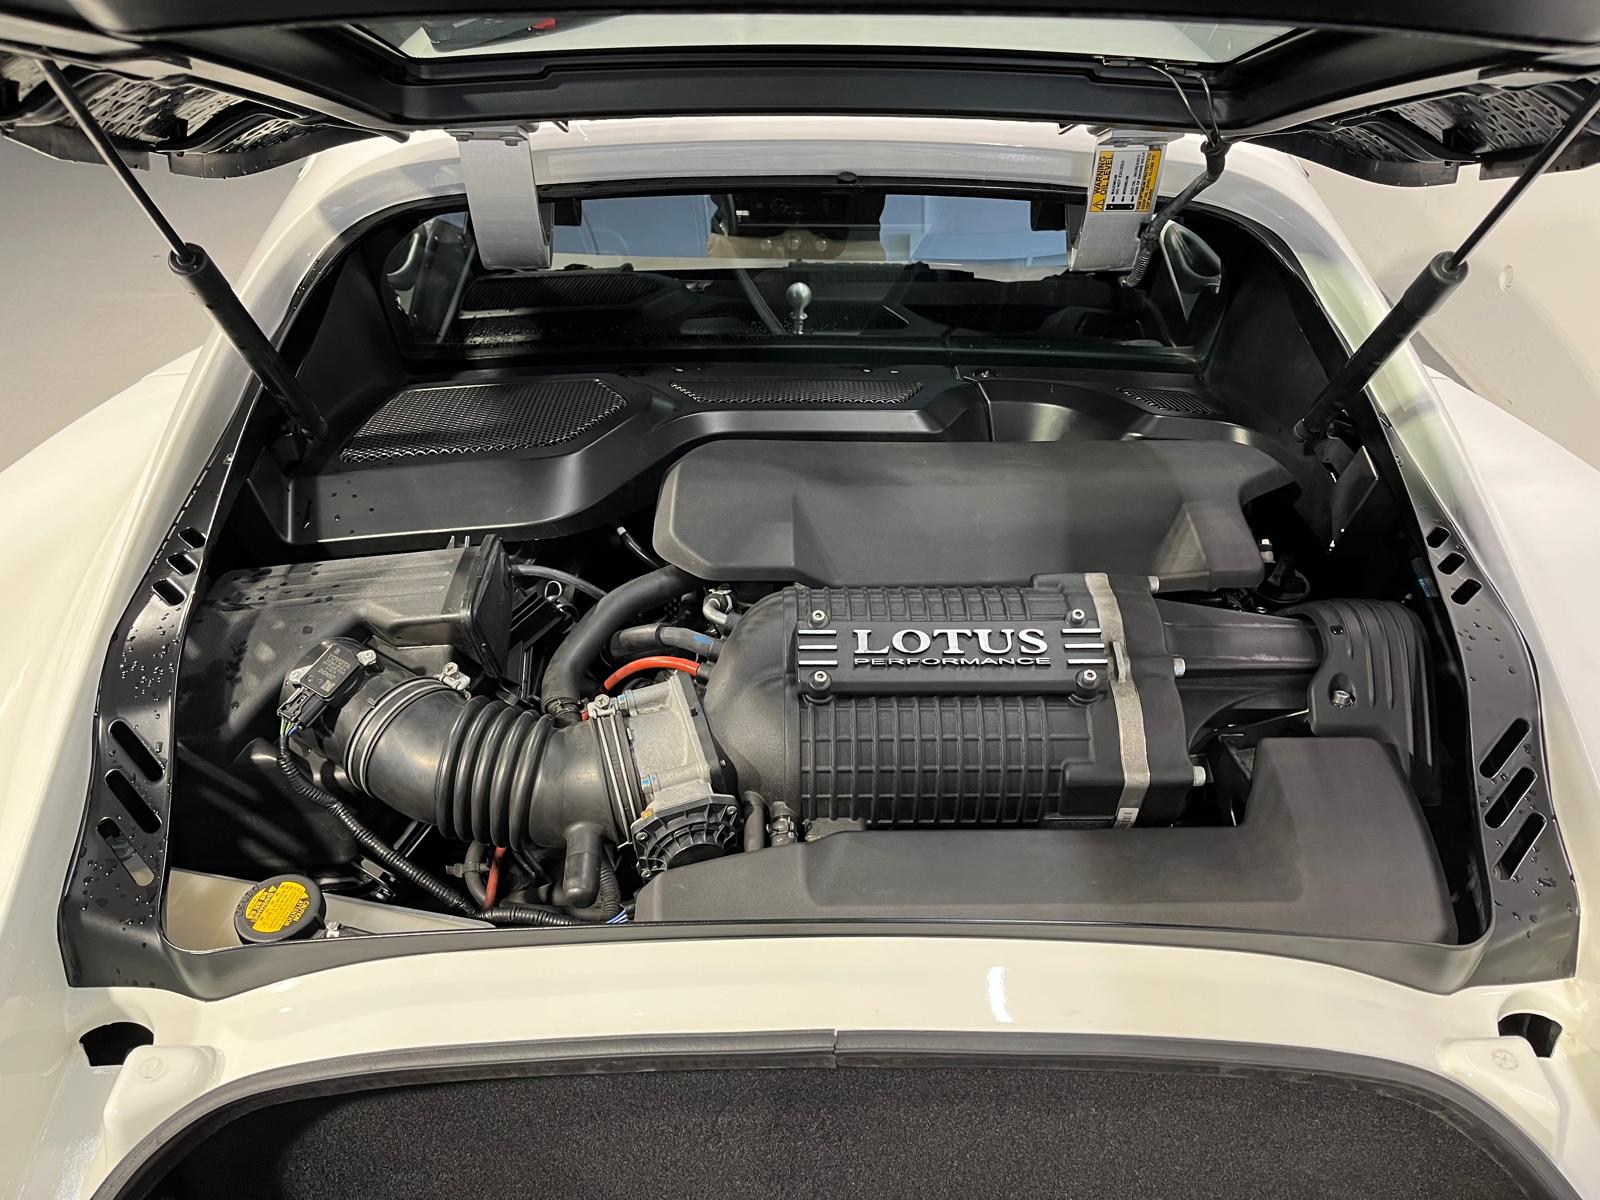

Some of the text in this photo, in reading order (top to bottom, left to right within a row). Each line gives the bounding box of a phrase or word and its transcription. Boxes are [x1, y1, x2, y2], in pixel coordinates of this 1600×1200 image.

[1093, 156, 1106, 194] WARNING
[1101, 155, 1112, 195] OIL LEVEL
[853, 629, 1048, 655] LOTUS
[854, 657, 1051, 667] PERFORMANCE
[284, 899, 304, 927] ATTENTION
[295, 900, 310, 922] CAUTION
